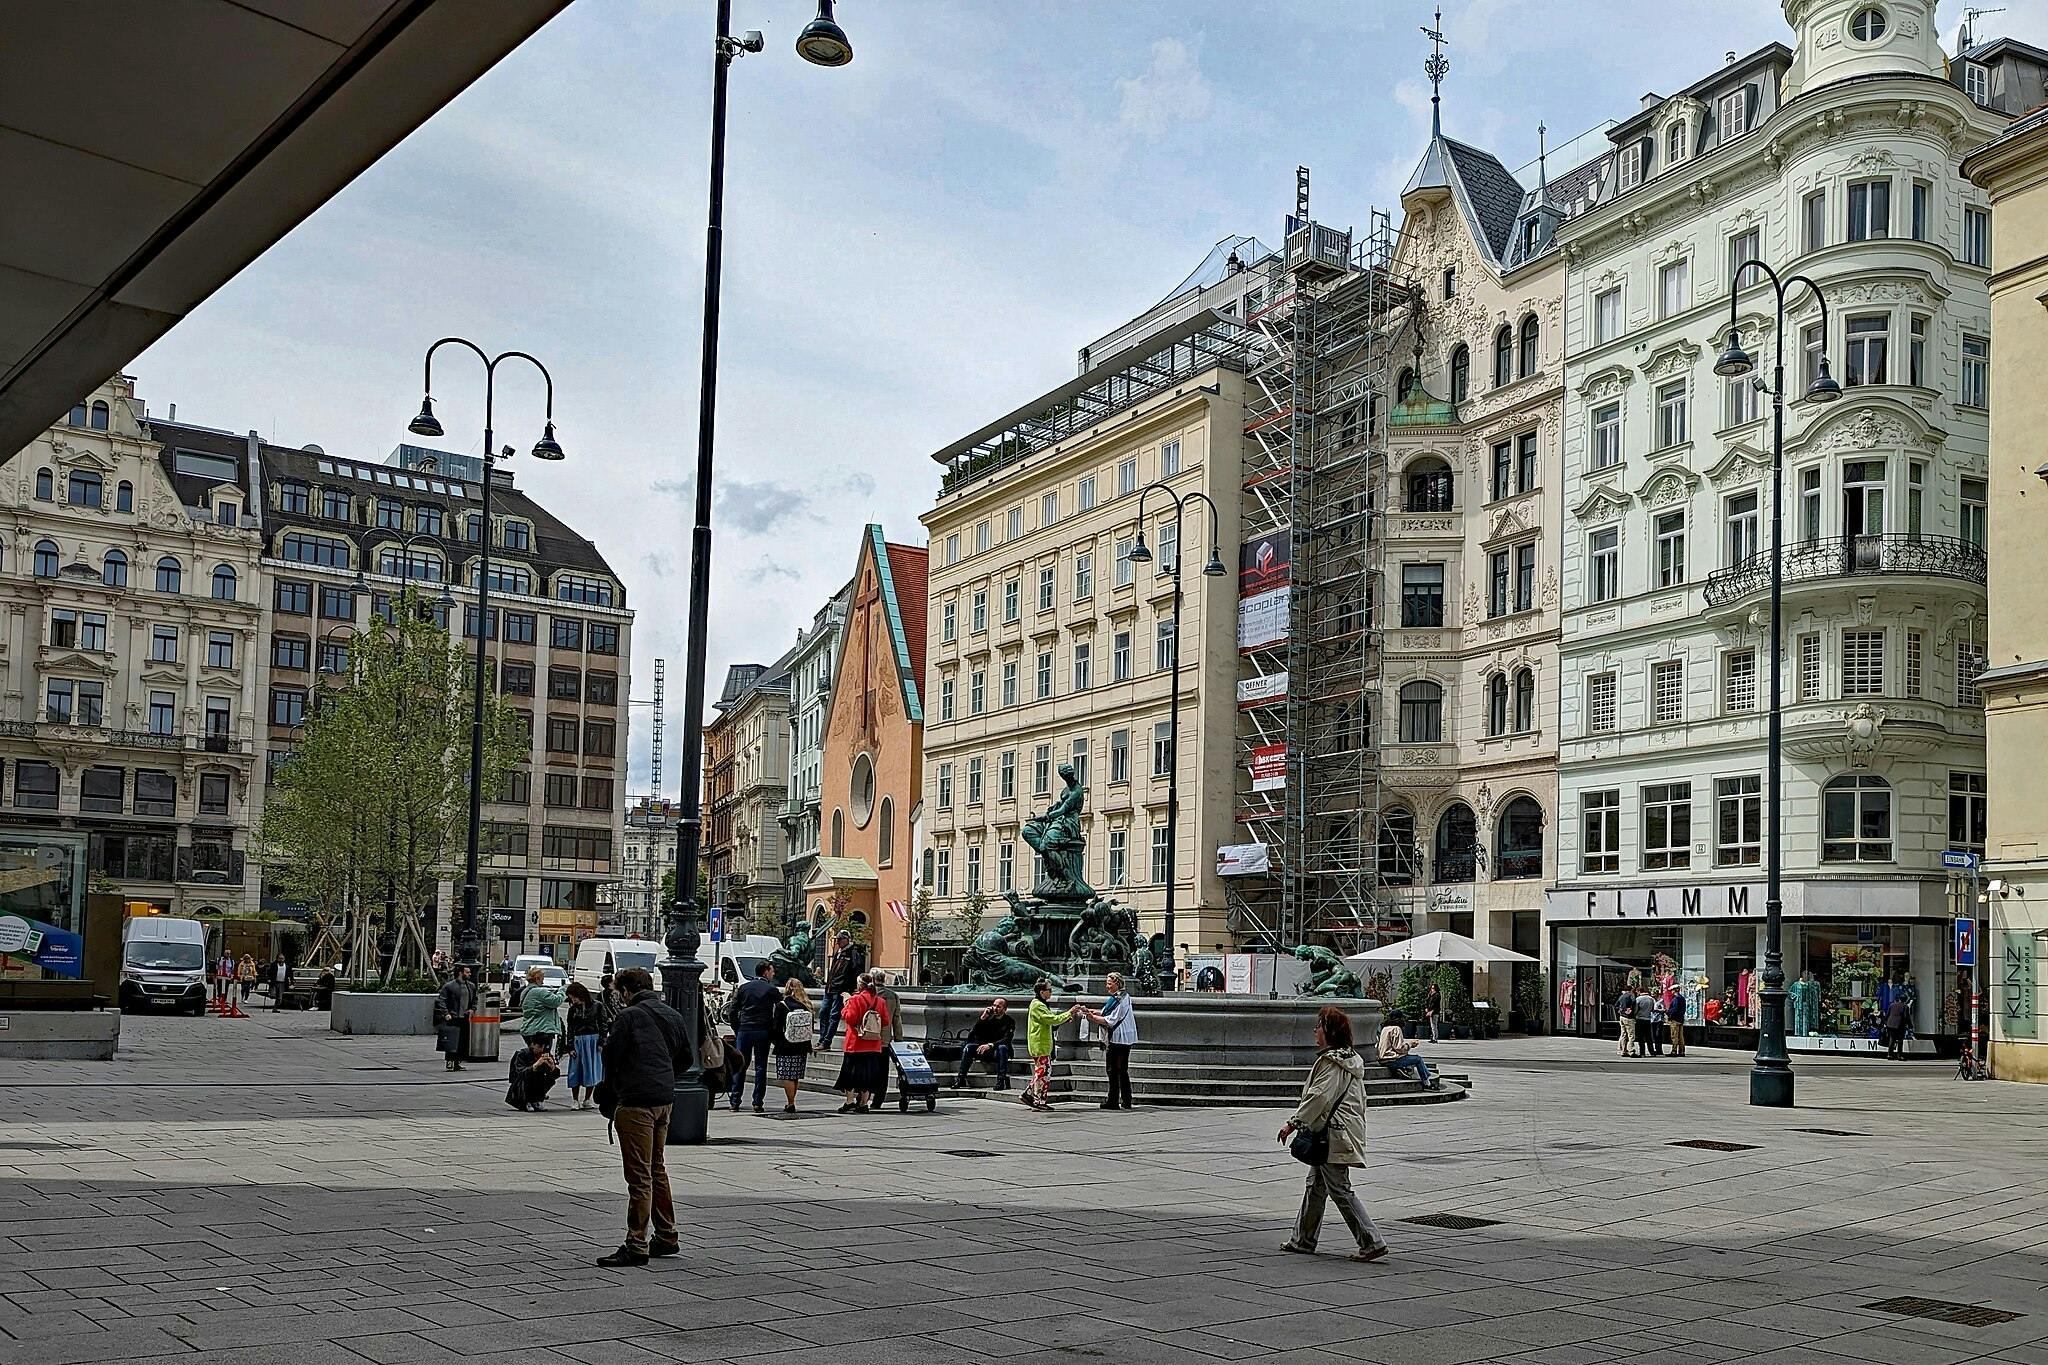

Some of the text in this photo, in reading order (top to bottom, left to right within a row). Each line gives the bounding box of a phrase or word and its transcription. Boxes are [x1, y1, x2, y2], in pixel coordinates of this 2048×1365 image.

[1245, 680, 1268, 690] OFFNER
[1946, 856, 1965, 864] EINBAHN
[1587, 886, 1749, 918] FLAMM
[2006, 946, 2021, 1019] KUNZ
[1818, 1039, 1898, 1051] FLAM
